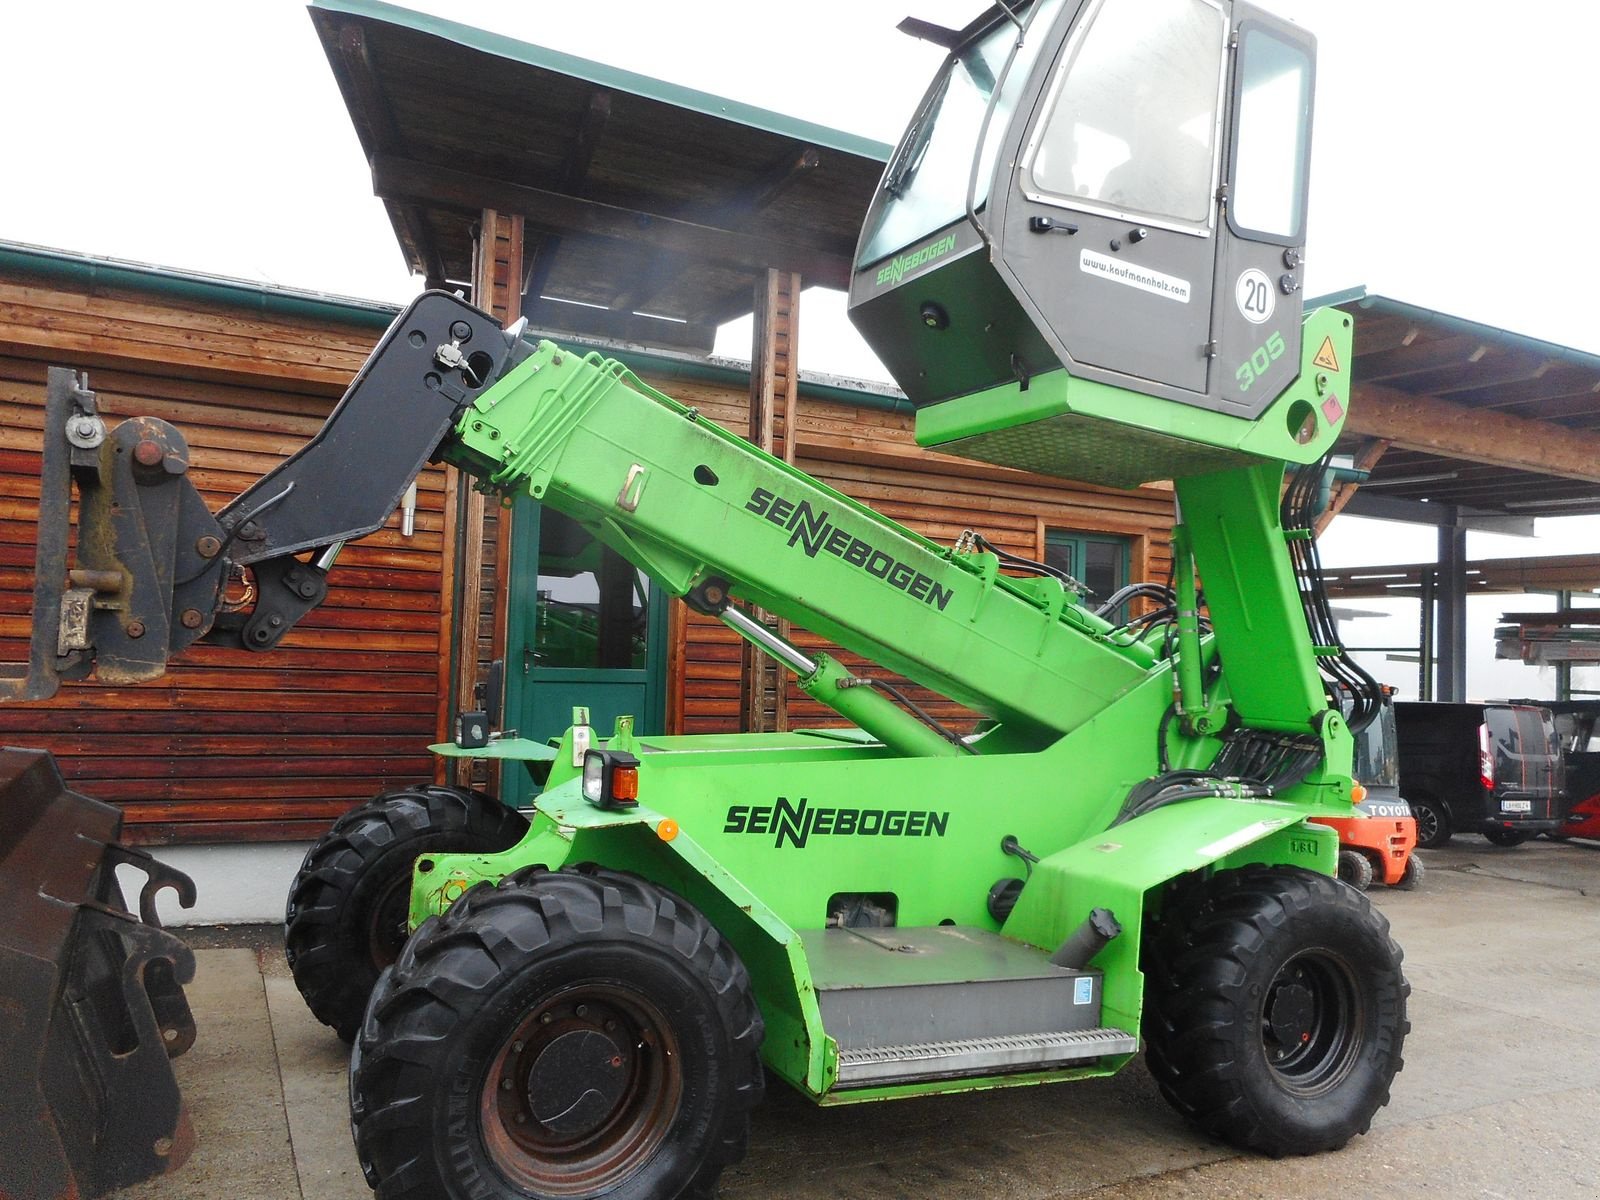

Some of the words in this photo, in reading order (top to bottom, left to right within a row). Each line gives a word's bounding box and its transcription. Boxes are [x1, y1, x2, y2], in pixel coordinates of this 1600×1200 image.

[876, 233, 956, 286] SENNEBOGEN
[1082, 255, 1188, 297] www.kaufmannholz.com
[1244, 278, 1267, 314] 20
[1235, 330, 1286, 392] 305
[744, 487, 954, 611] SENNEBOGEN
[723, 797, 950, 848] SENNEBOGEN
[1368, 804, 1411, 817] TOYOTA
